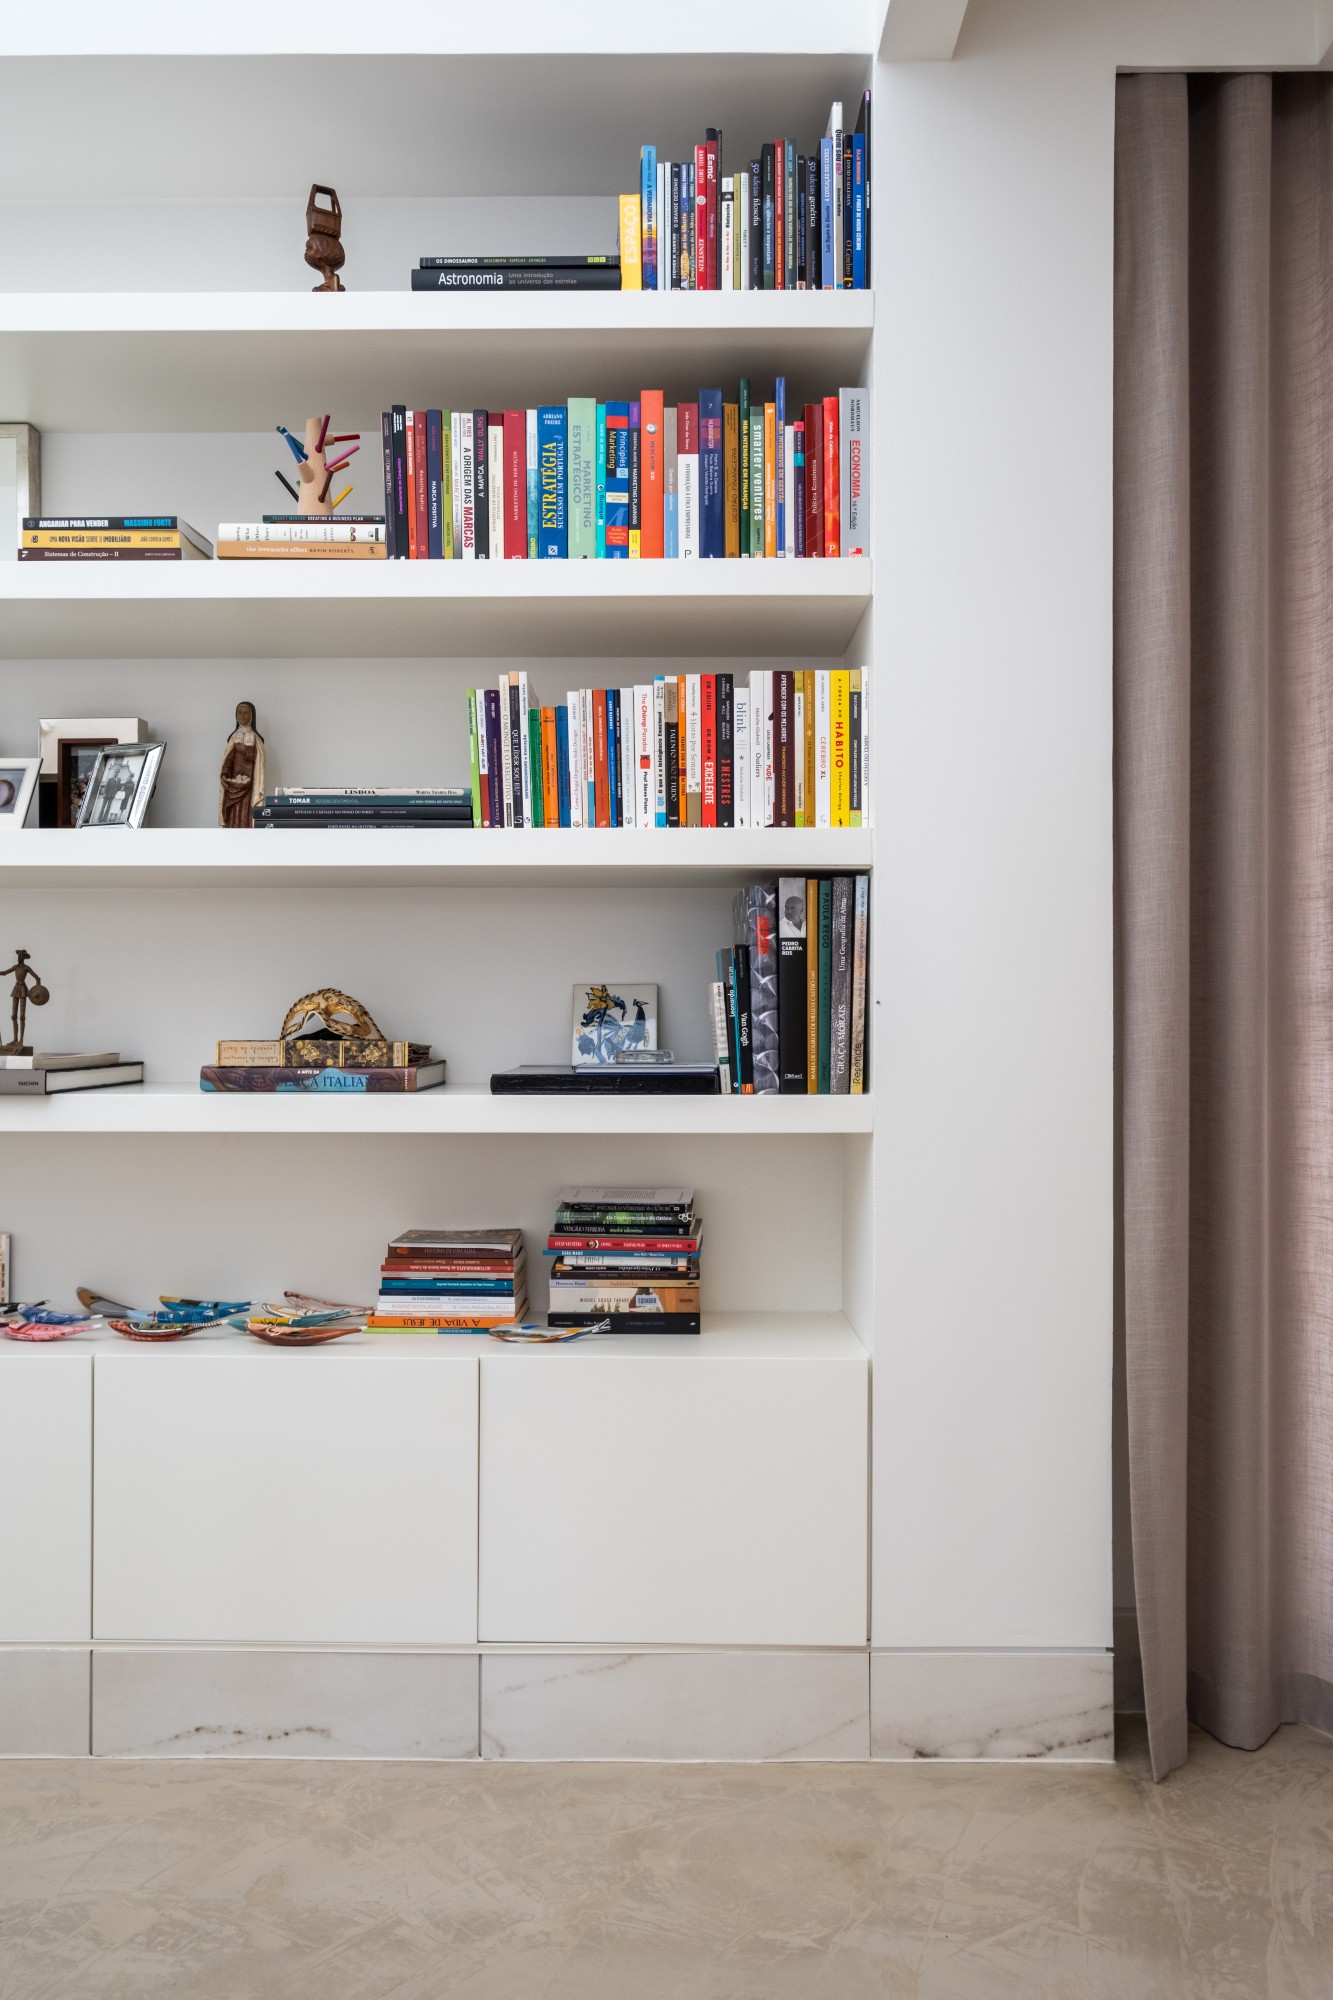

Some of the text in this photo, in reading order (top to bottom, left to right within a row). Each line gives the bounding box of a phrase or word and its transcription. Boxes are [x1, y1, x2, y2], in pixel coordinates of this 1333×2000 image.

[751, 162, 760, 173] 50
[808, 160, 816, 171] 50
[808, 196, 817, 227] genética
[624, 205, 639, 263] ESPAÇO
[438, 272, 503, 285] Astronomia
[573, 425, 584, 504] ESTRATÉGICO
[607, 431, 616, 469] Marketing
[619, 431, 627, 467] Principles
[463, 455, 472, 486] ORIGEM
[541, 442, 557, 528] ESTRATÉGIA
[754, 424, 763, 521] smarter ventures
[464, 489, 472, 504] DAS
[557, 482, 564, 494] EM
[583, 460, 591, 528] MARKETING
[39, 520, 109, 528] ANGARIAR PARA VENDER
[124, 518, 172, 527] MASSIMO FORTE
[464, 506, 474, 548] MARCAS
[736, 702, 747, 733] blink
[835, 721, 845, 768] HÁBITO
[704, 761, 714, 805] EXCELENTE
[721, 766, 730, 805] MESTRES
[820, 770, 827, 779] XL
[839, 897, 847, 915] Alma
[839, 924, 847, 955] Geografia
[839, 956, 847, 971] Uma
[727, 990, 735, 1017] Leonardo
[740, 1027, 749, 1046] Gogh
[837, 1004, 847, 1074] GRAÇA MORAIS
[853, 1043, 863, 1084] Resende
[233, 1076, 381, 1088] RENASCENÇA ITALIANA
[403, 1318, 481, 1326] A VIDA DE JESUS
